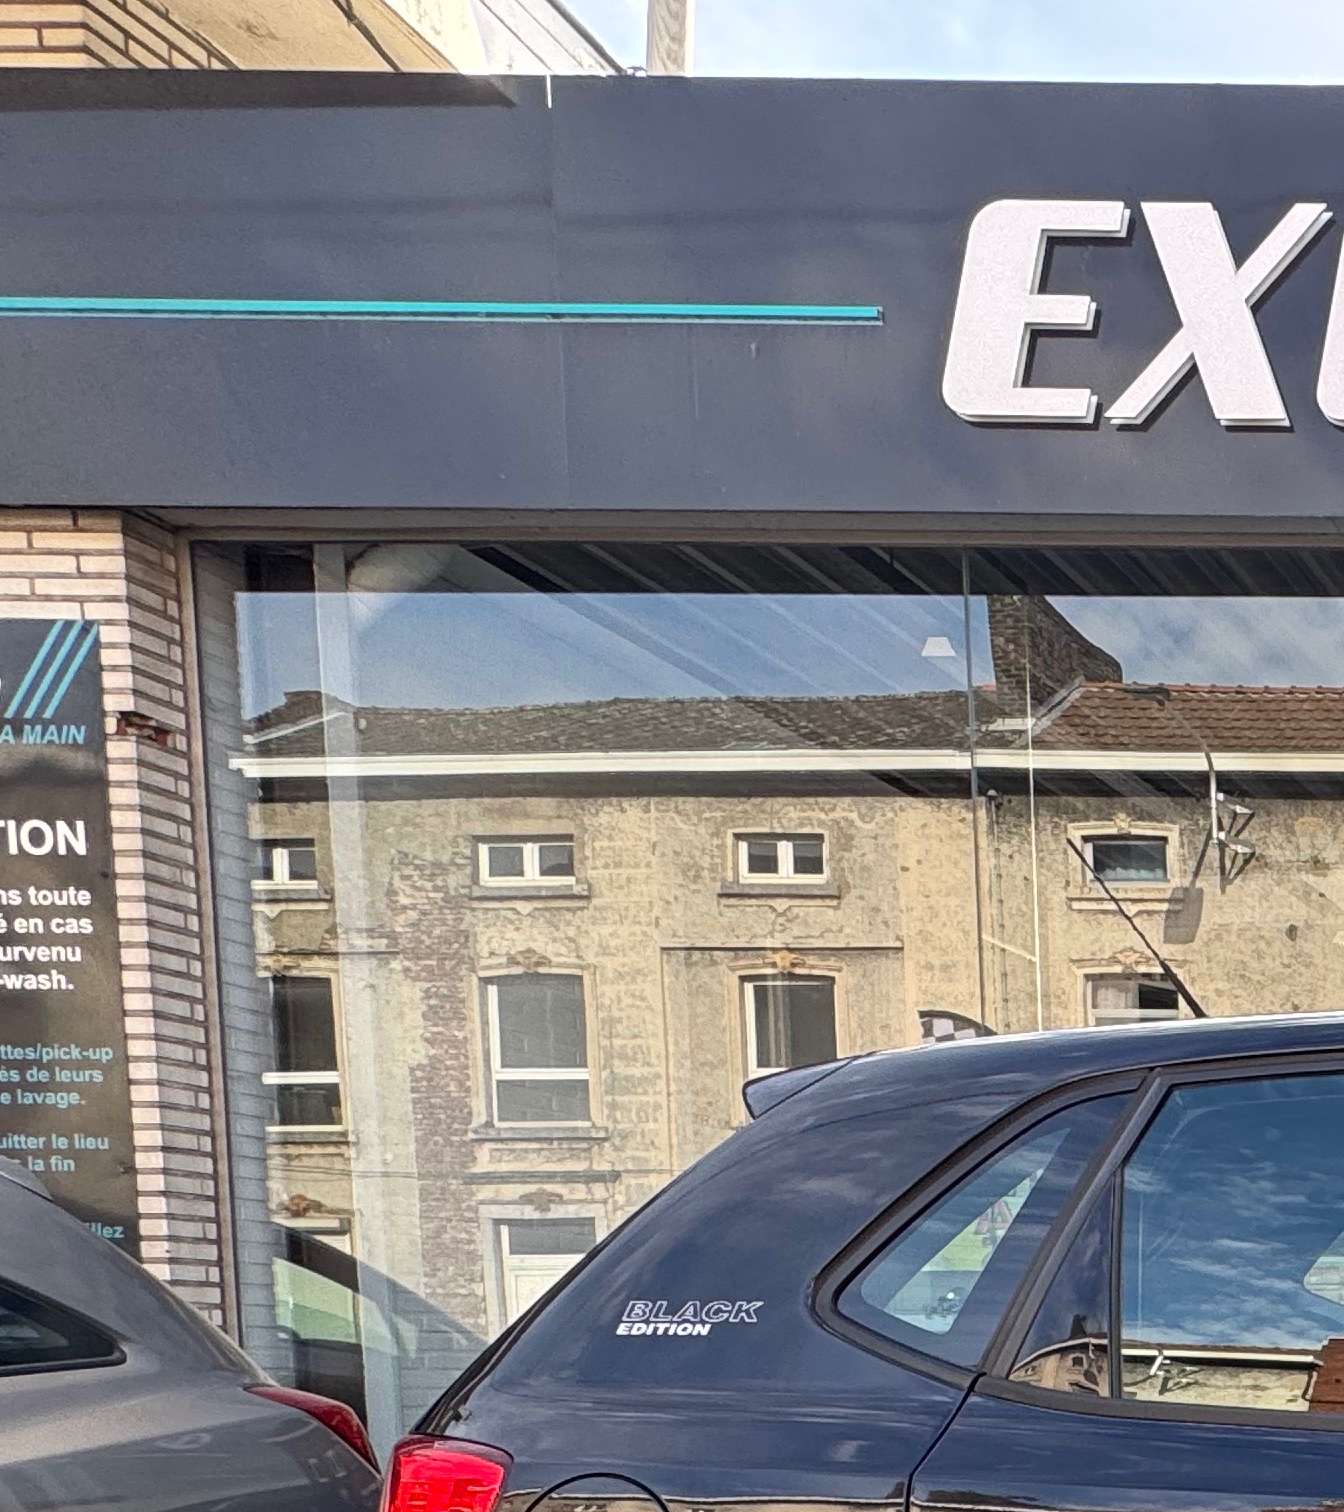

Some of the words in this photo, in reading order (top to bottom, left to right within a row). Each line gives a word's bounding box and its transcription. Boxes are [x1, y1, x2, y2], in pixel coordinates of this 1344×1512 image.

[22, 725, 87, 745] MAIN
[28, 885, 92, 906] toute
[14, 918, 44, 934] en
[50, 918, 94, 934] cas
[26, 1066, 49, 1083] de
[55, 1066, 104, 1083] leurs
[17, 1088, 86, 1108] lavage.
[51, 1133, 69, 1150] le
[74, 1133, 110, 1150] lieu
[28, 1155, 45, 1172] la
[50, 1155, 75, 1172] fin
[621, 1300, 765, 1322] BLACK
[616, 1322, 712, 1336] EDITION
